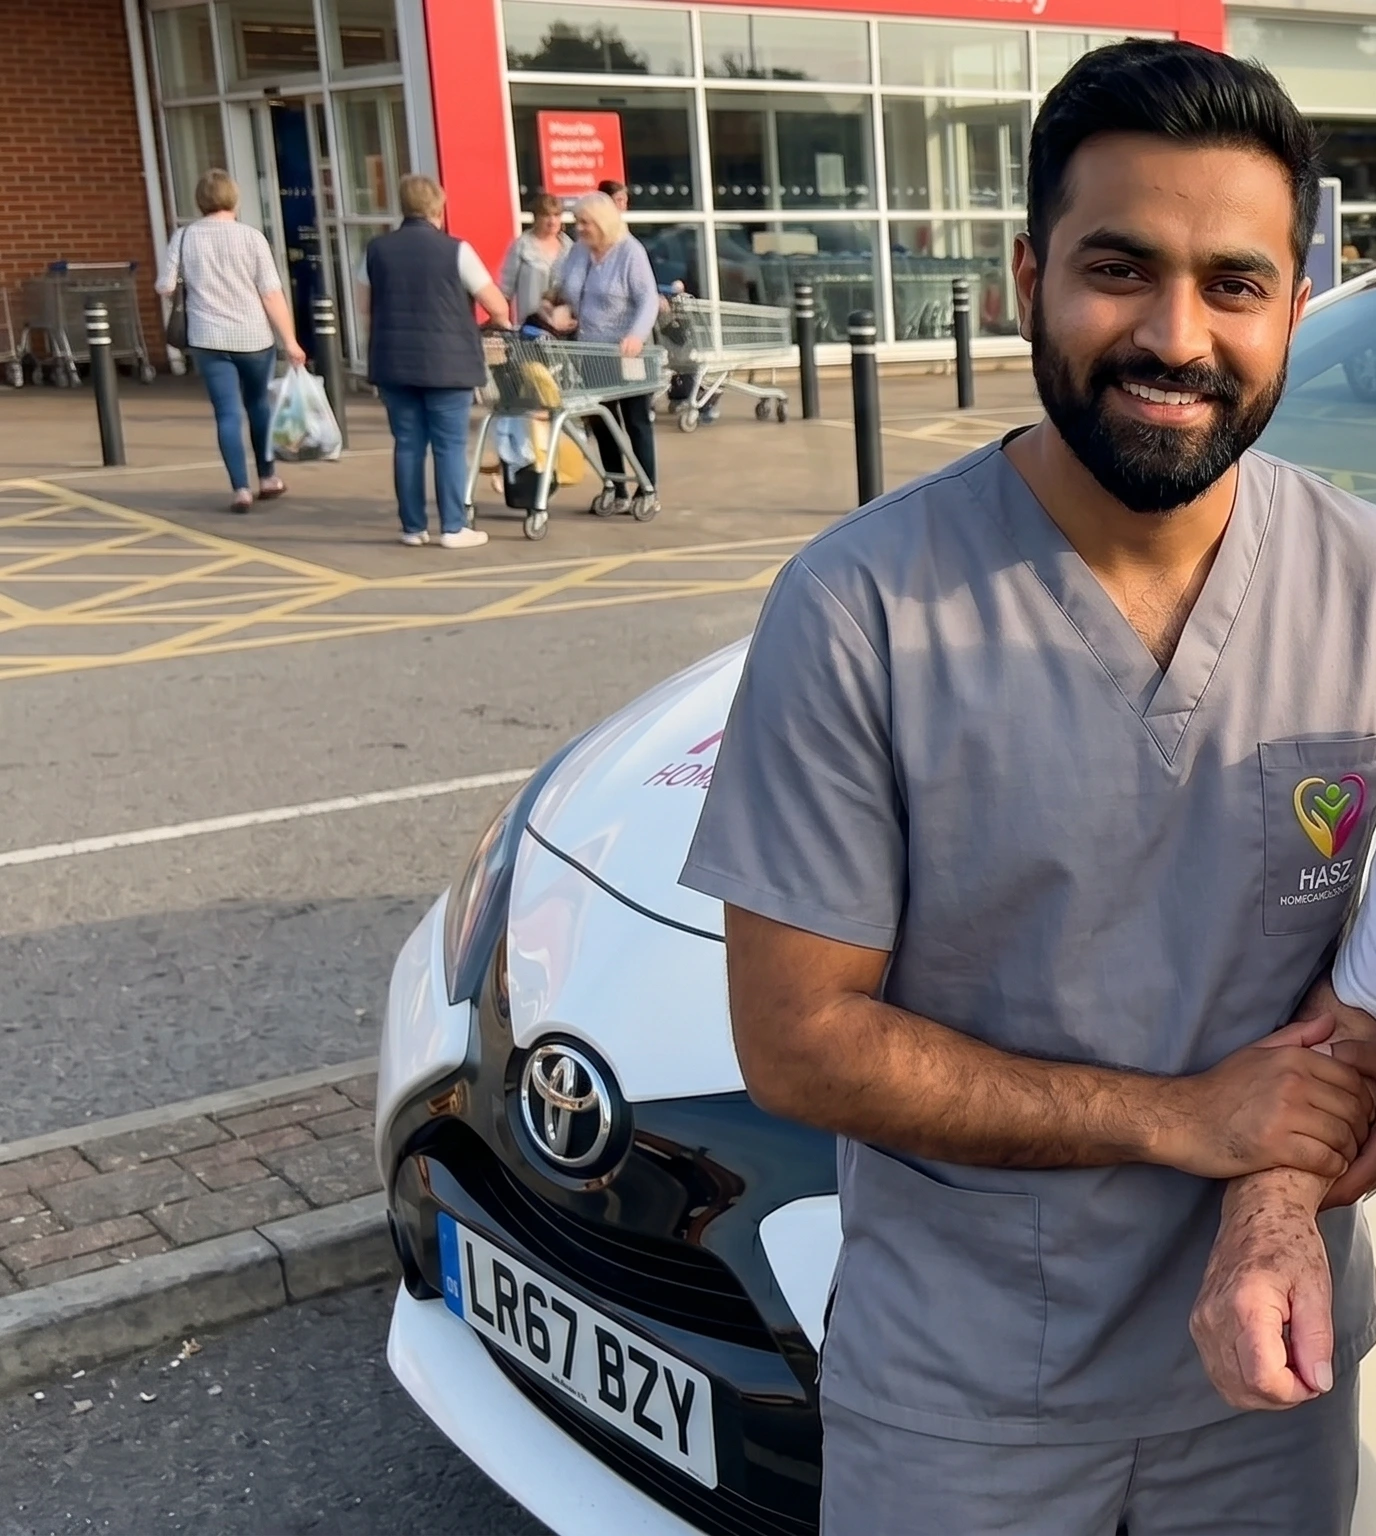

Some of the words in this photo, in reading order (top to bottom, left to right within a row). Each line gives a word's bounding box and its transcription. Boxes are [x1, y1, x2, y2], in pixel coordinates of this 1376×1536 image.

[1299, 859, 1353, 890] HASZ
[466, 1241, 577, 1380] LR67
[594, 1324, 695, 1456] BZY
